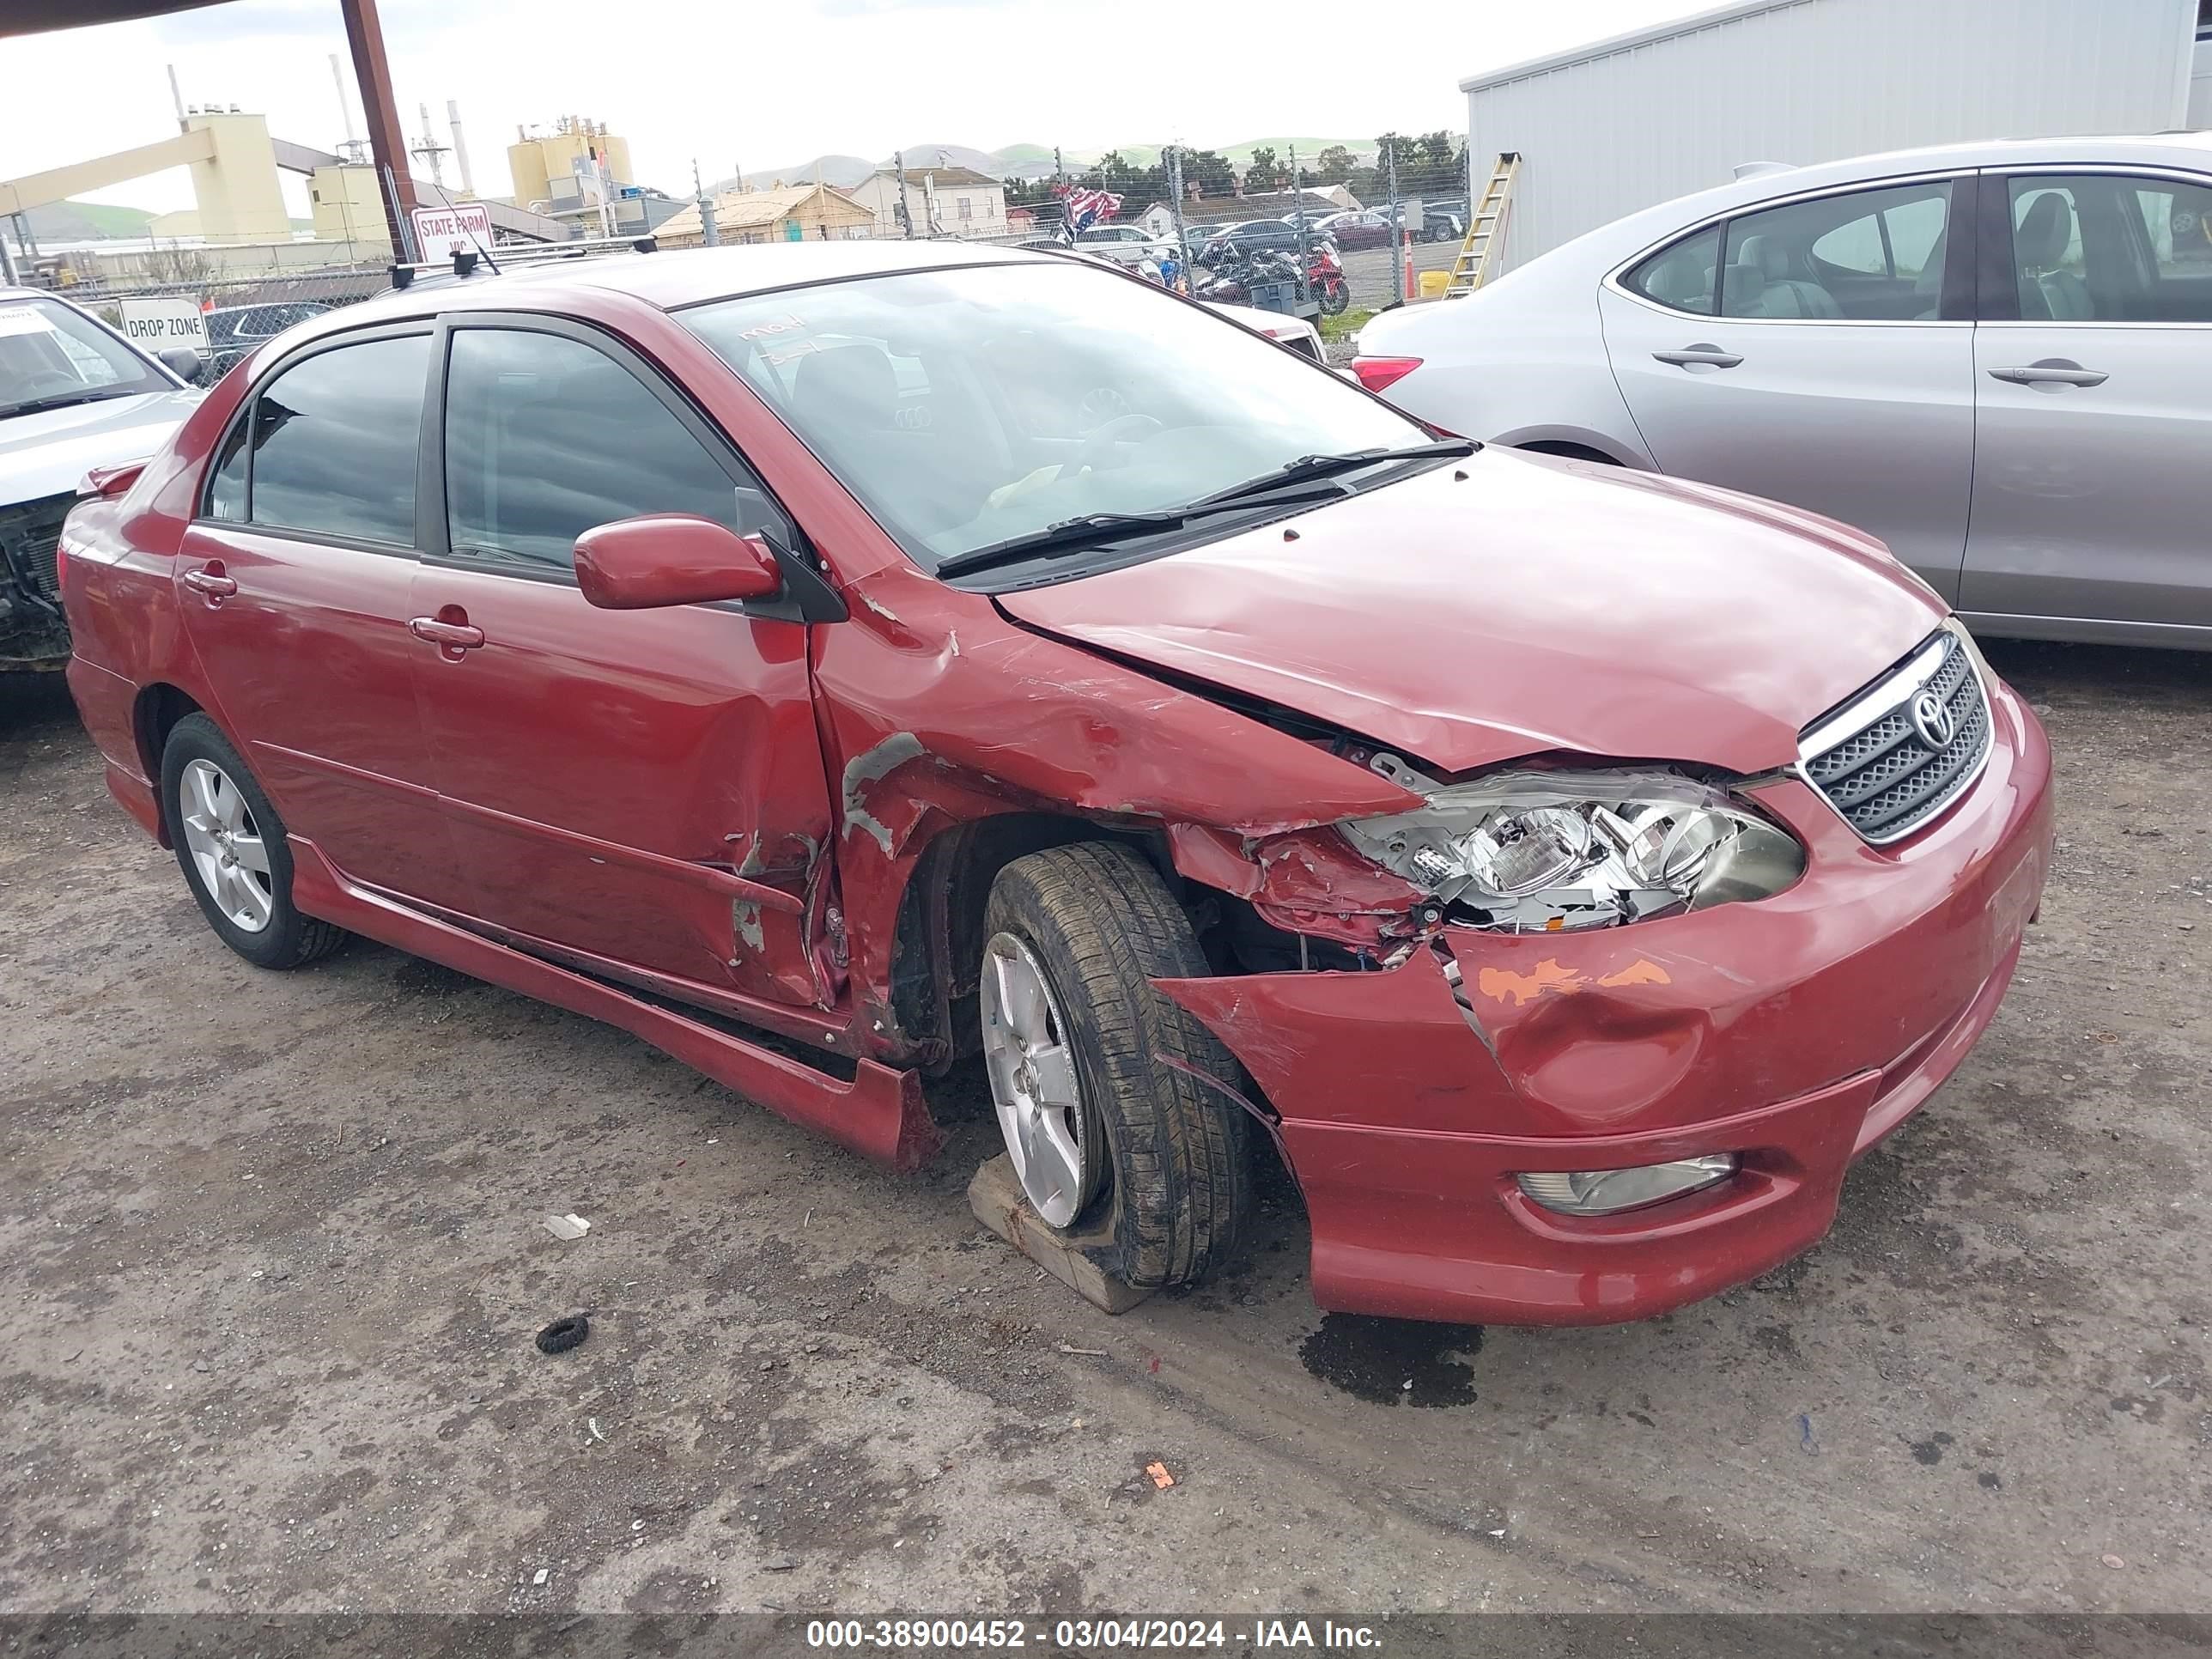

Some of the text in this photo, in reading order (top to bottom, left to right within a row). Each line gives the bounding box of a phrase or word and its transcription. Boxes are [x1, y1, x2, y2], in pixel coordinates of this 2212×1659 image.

[421, 214, 486, 237] STATE FARM
[128, 317, 203, 337] DROP ZONE
